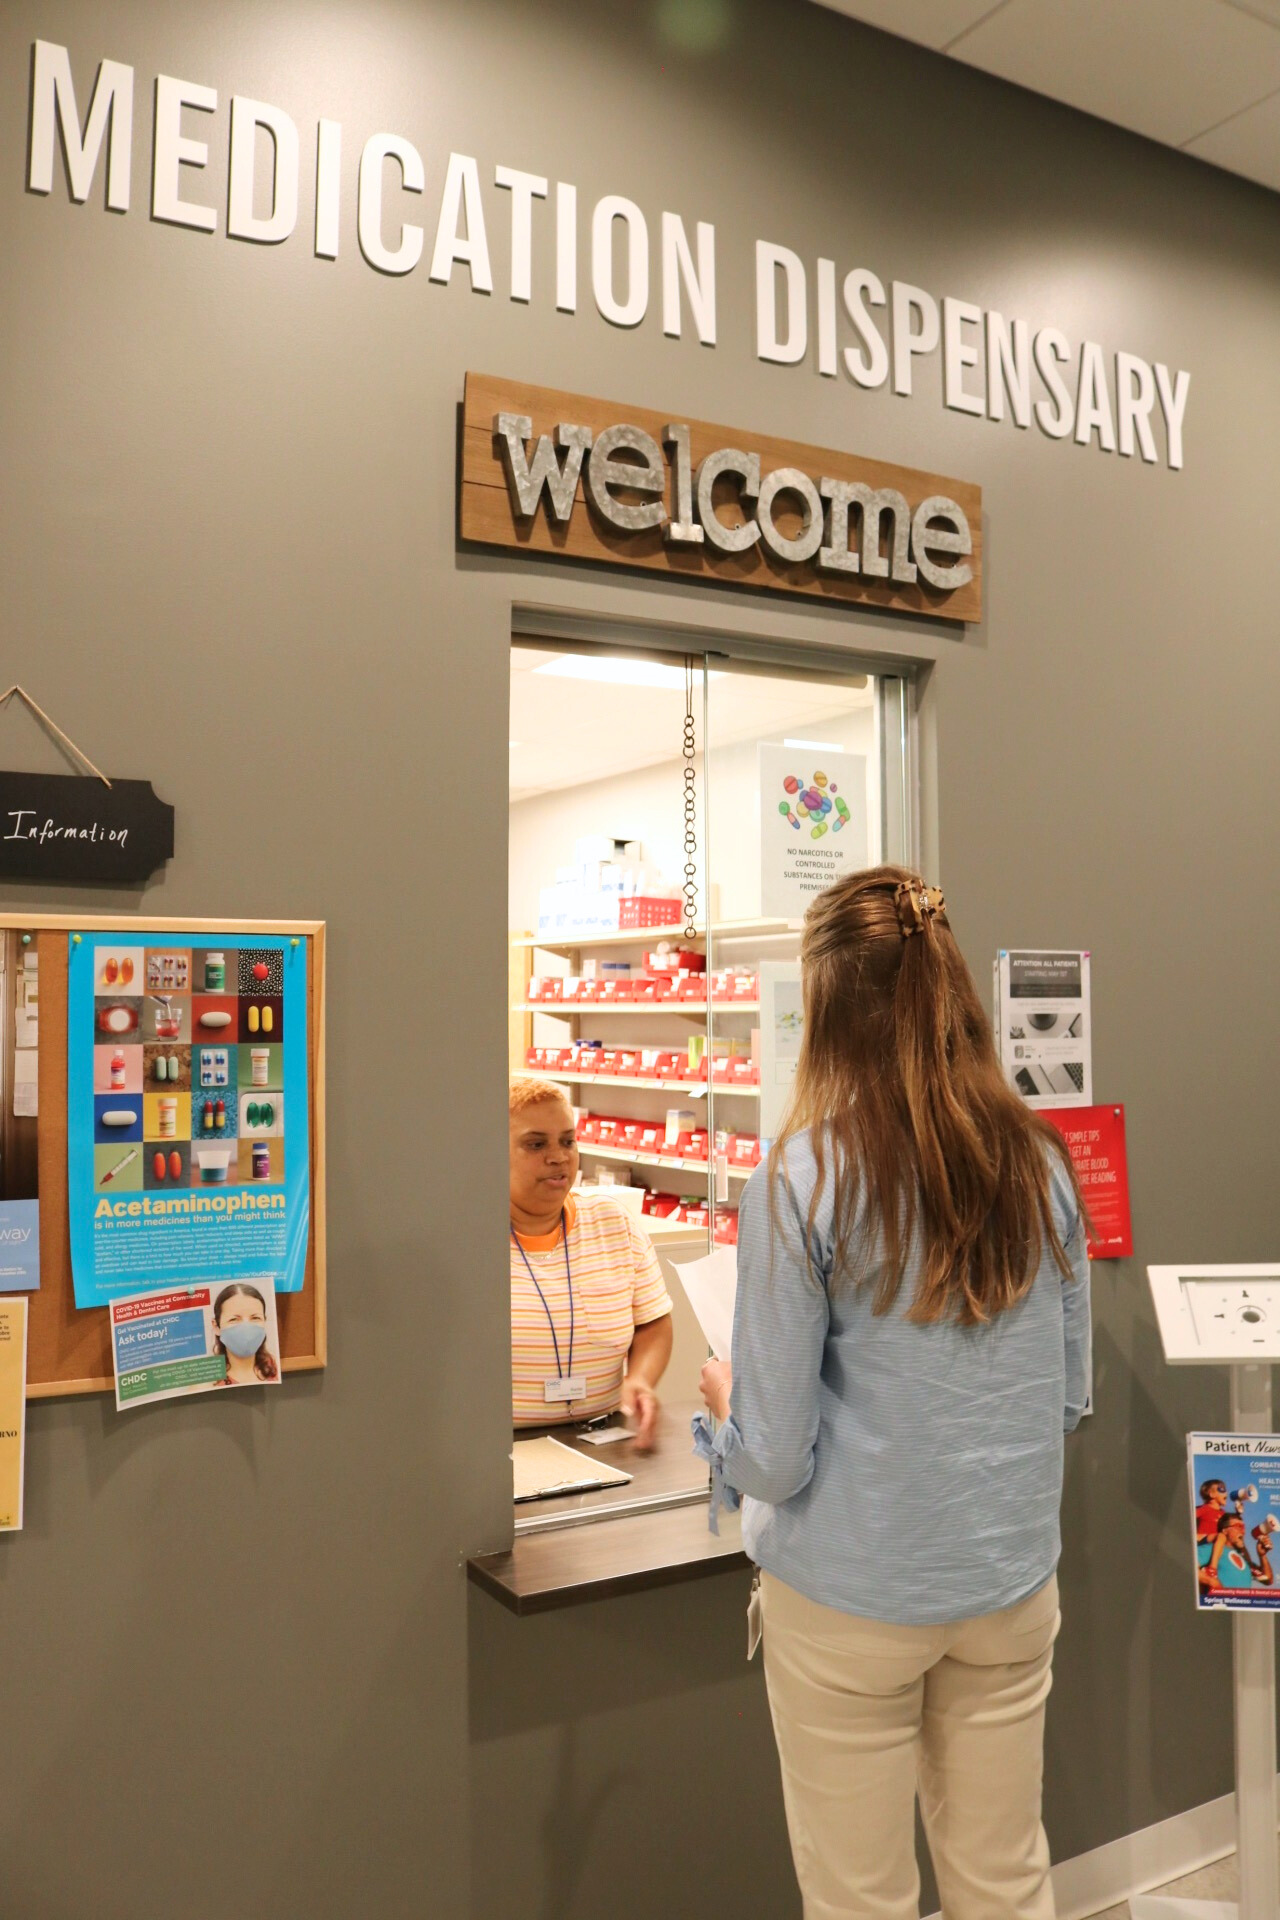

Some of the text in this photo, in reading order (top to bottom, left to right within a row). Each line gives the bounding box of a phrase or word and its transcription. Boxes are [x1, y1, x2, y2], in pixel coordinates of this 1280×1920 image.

[28, 39, 1191, 469] MEDICATION DISPENSARY
[494, 412, 973, 590] welcome
[4, 810, 129, 848] Information
[787, 848, 844, 859] NO NARCOTICS OR
[795, 860, 836, 869] CONTROLLED
[783, 871, 823, 880] SUBSTANCES
[824, 873, 834, 881] ON
[1069, 1131, 1088, 1144] SIMPLE
[1088, 1130, 1101, 1142] TIPS
[1072, 1146, 1082, 1158] GET
[1082, 1145, 1092, 1156] AN
[1090, 1157, 1109, 1170] BLOOD
[1090, 1171, 1117, 1184] READING
[94, 1192, 286, 1218] Acetaminophen
[94, 1210, 286, 1230] is in more medicines than you might think
[115, 1304, 140, 1314] COVID-19
[140, 1299, 165, 1308] Vaccines
[172, 1292, 205, 1303] Community
[116, 1311, 133, 1320] Health
[138, 1306, 156, 1315] Dental
[127, 1320, 155, 1332] Vaccinated
[162, 1316, 180, 1325] CHDC
[118, 1326, 168, 1347] Ask today!
[121, 1372, 148, 1386] CHDC
[1205, 1440, 1251, 1453] Patient
